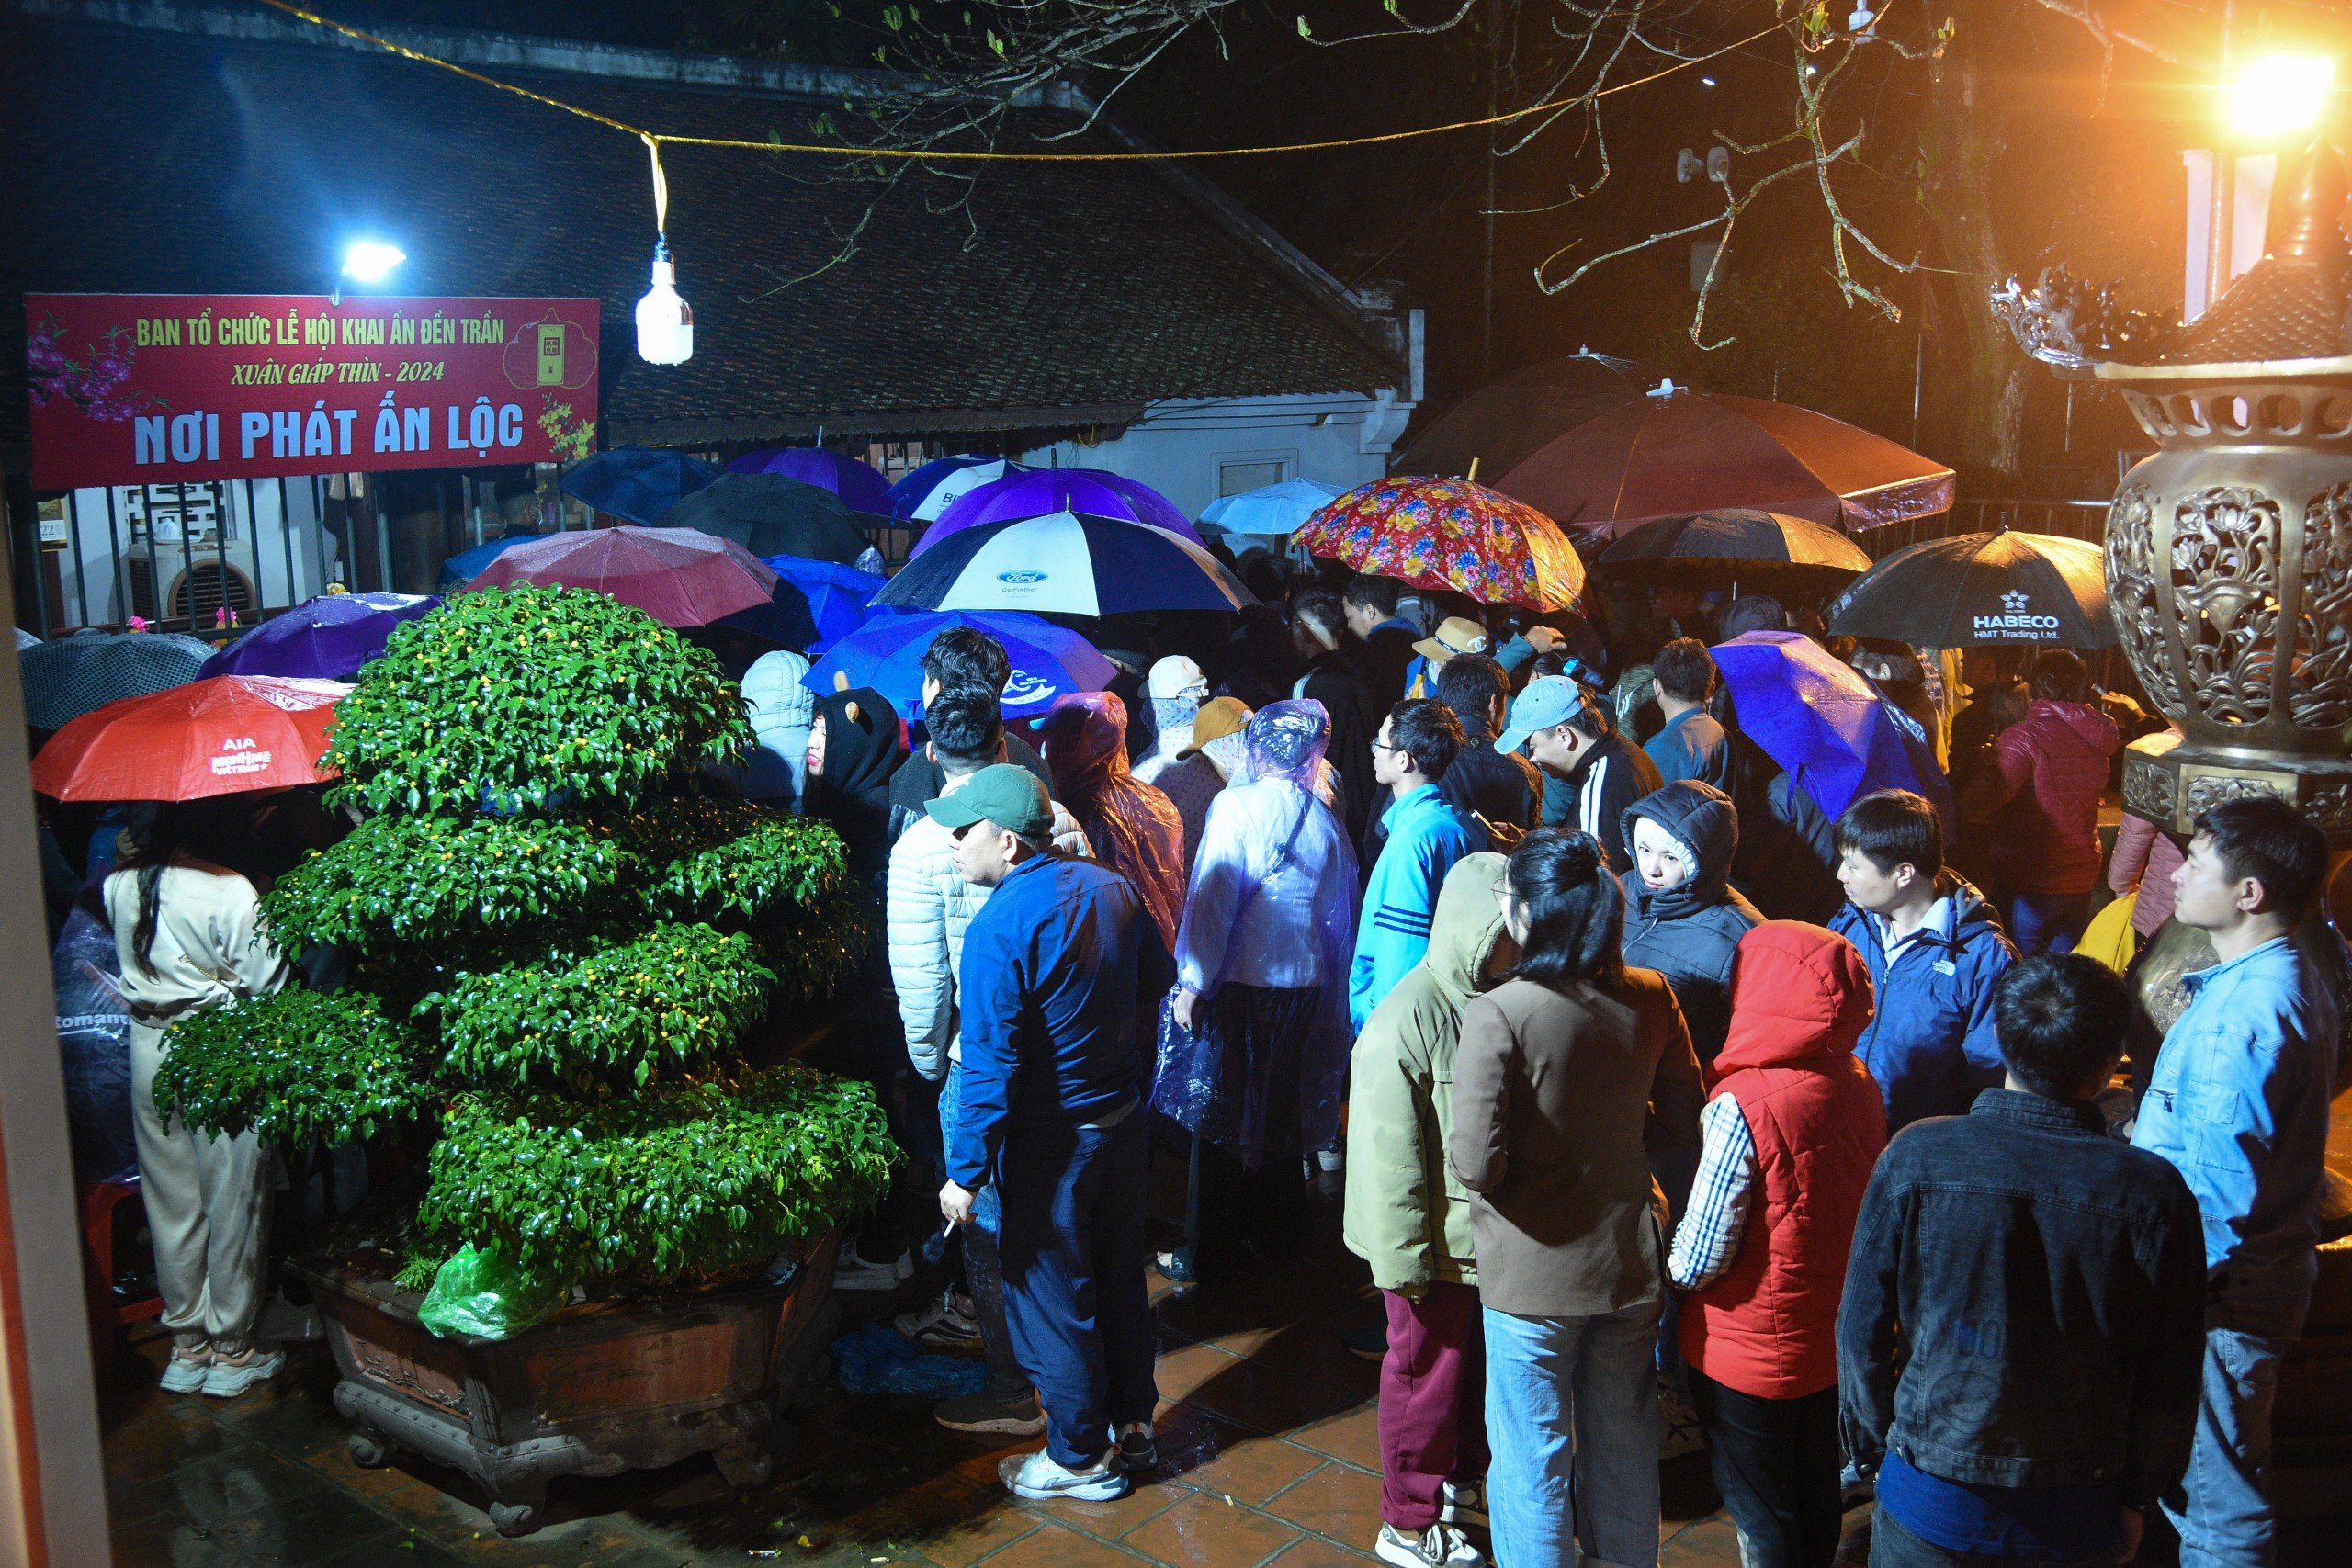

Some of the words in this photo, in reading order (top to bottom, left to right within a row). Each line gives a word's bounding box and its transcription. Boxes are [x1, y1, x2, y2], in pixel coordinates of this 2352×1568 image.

[137, 318, 181, 346] BAN
[186, 306, 212, 346] TỔ
[218, 311, 272, 345] CHỨC
[277, 308, 300, 345] LỄ
[304, 312, 336, 351] HỘI
[342, 318, 385, 344] KHAI
[390, 309, 415, 344] ẤN
[420, 310, 456, 344] ĐỀN
[460, 310, 504, 344] TRẦN
[231, 357, 287, 386] XUÂN
[288, 356, 334, 385] GIÁP
[337, 355, 383, 384] THÌN
[395, 361, 445, 383] 2024
[134, 410, 220, 465] NƠI
[241, 400, 358, 459] PHÁT
[373, 389, 431, 453] ẤN
[447, 396, 524, 458] LỘC
[943, 492, 961, 504] BI
[40, 524, 55, 536] 22
[1006, 571, 1039, 581] Ford
[1973, 616, 2059, 628] HABECO
[2001, 630, 2038, 639] Trading
[223, 738, 256, 750] AIA
[55, 1014, 132, 1028] Romant
